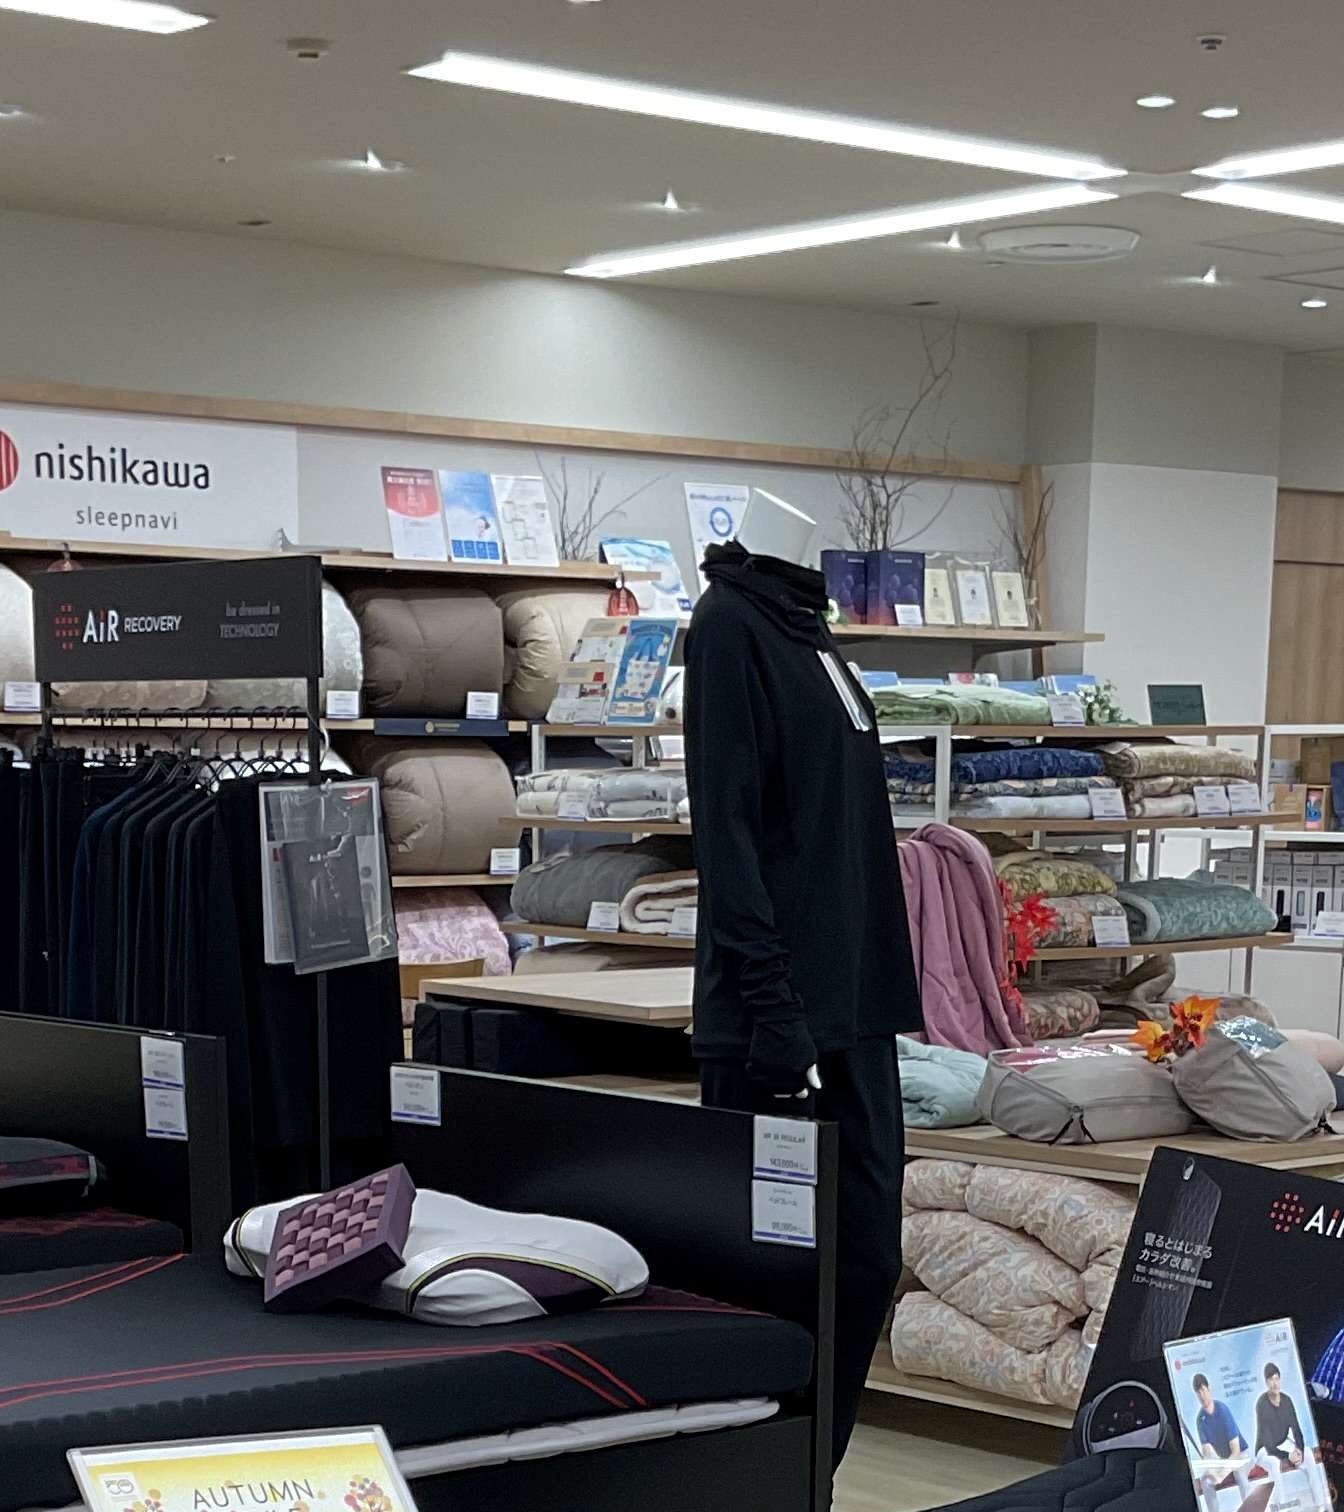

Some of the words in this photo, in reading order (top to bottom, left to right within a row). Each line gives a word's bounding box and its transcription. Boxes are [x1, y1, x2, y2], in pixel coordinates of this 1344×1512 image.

[34, 443, 210, 490] nishikawa
[75, 505, 178, 532] sleepnavi
[82, 608, 119, 643] AiR
[123, 615, 182, 633] RECOVERY
[219, 622, 280, 639] TECHNOLOGY
[193, 1478, 315, 1510] AUTUMN
